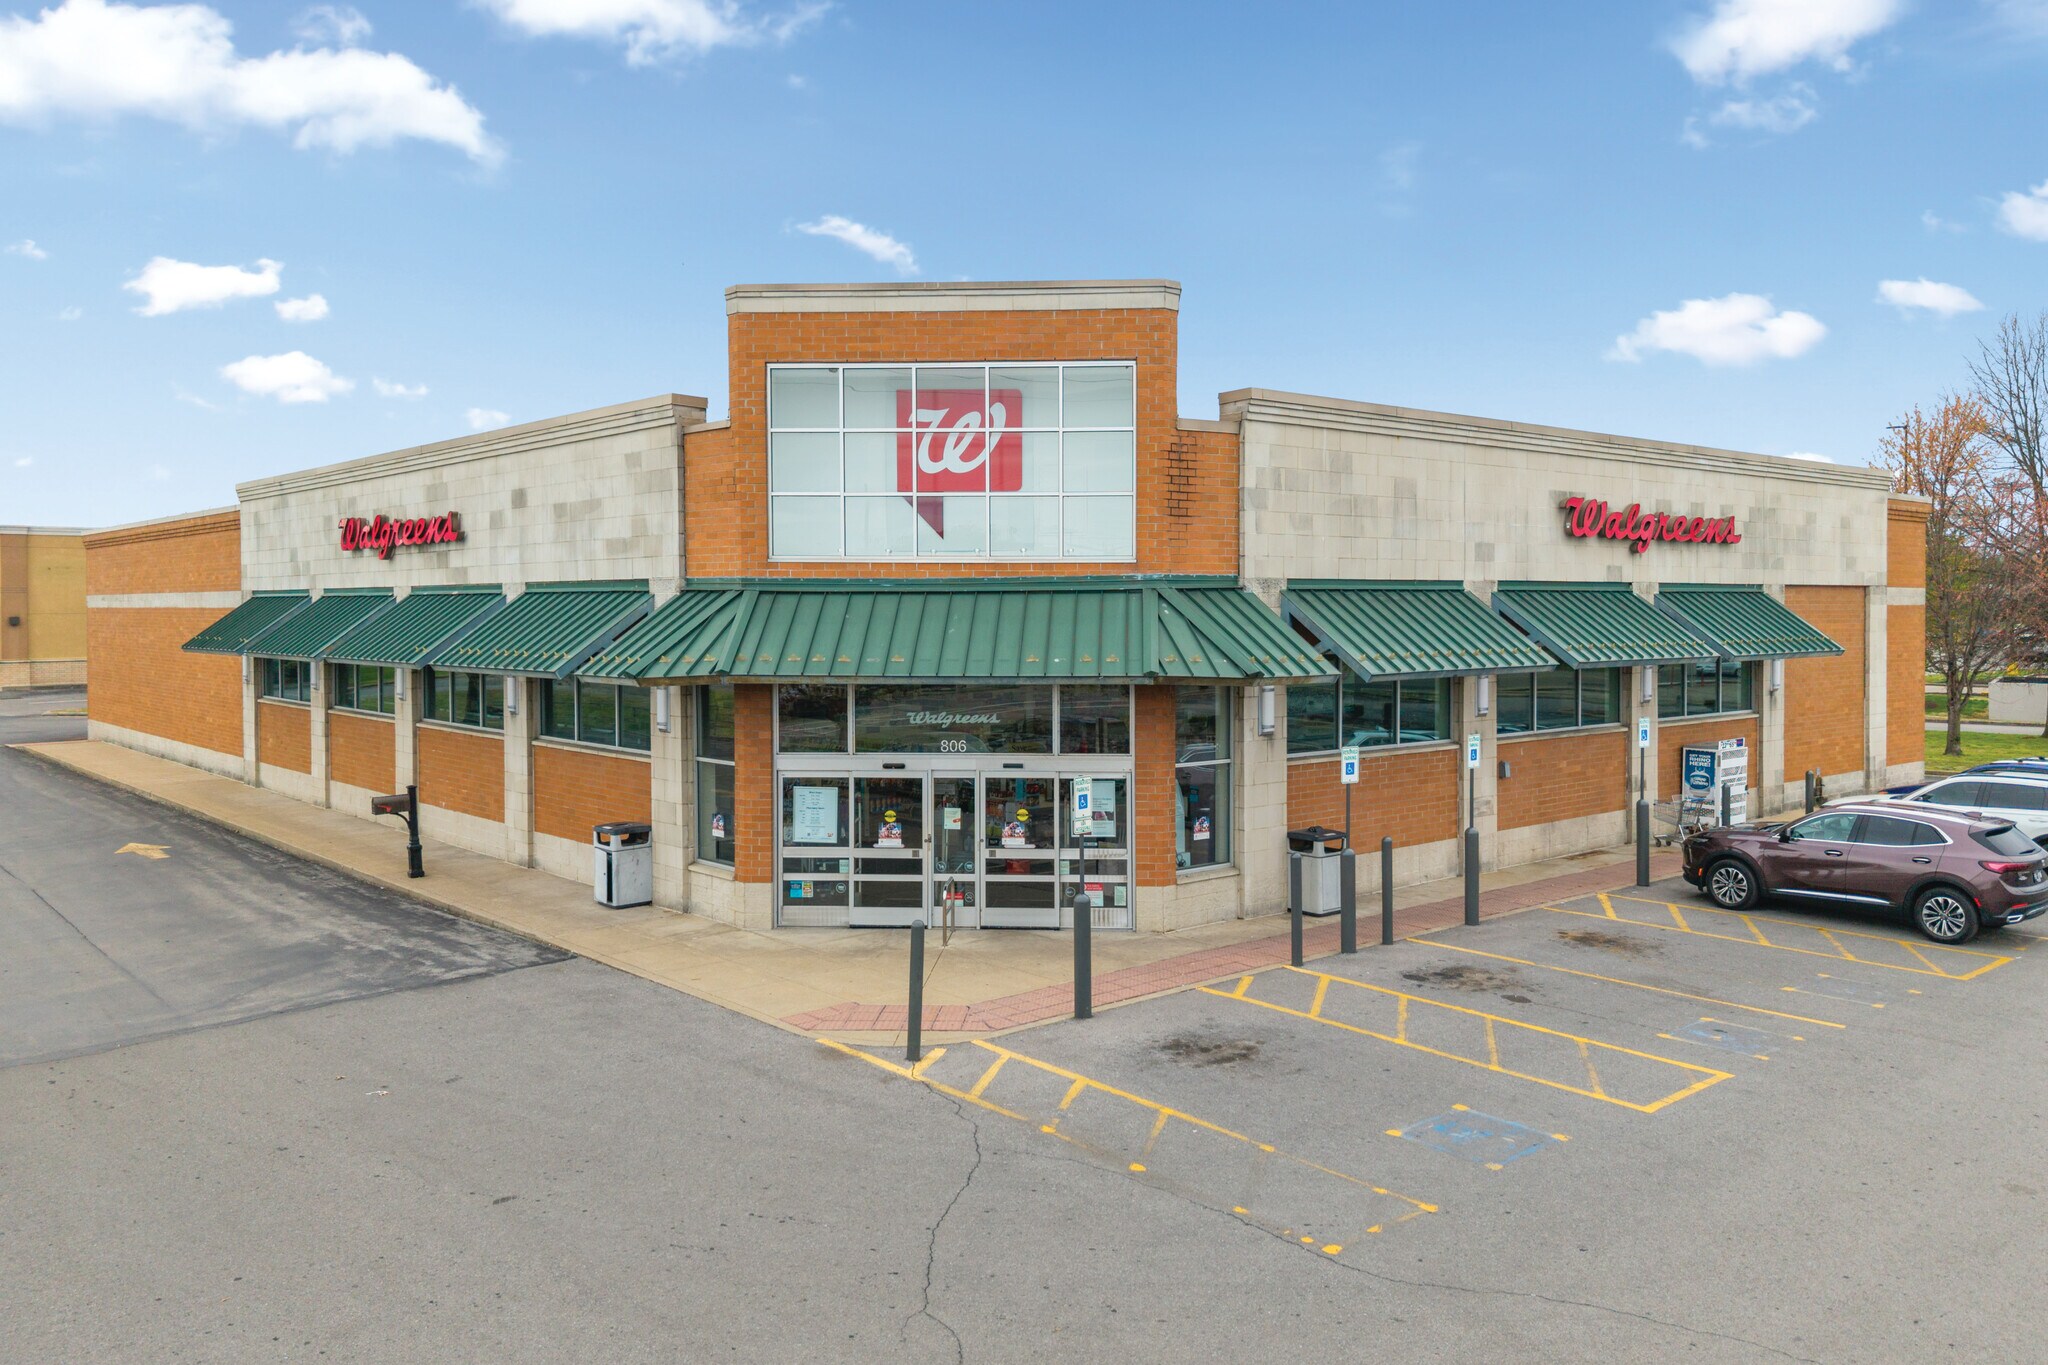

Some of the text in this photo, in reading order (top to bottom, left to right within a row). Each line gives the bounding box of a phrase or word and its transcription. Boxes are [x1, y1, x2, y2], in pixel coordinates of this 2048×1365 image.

[338, 511, 460, 560] Walgreens
[1565, 496, 1742, 554] Walgreens
[906, 711, 1000, 728] Walgreens
[940, 740, 967, 752] 806
